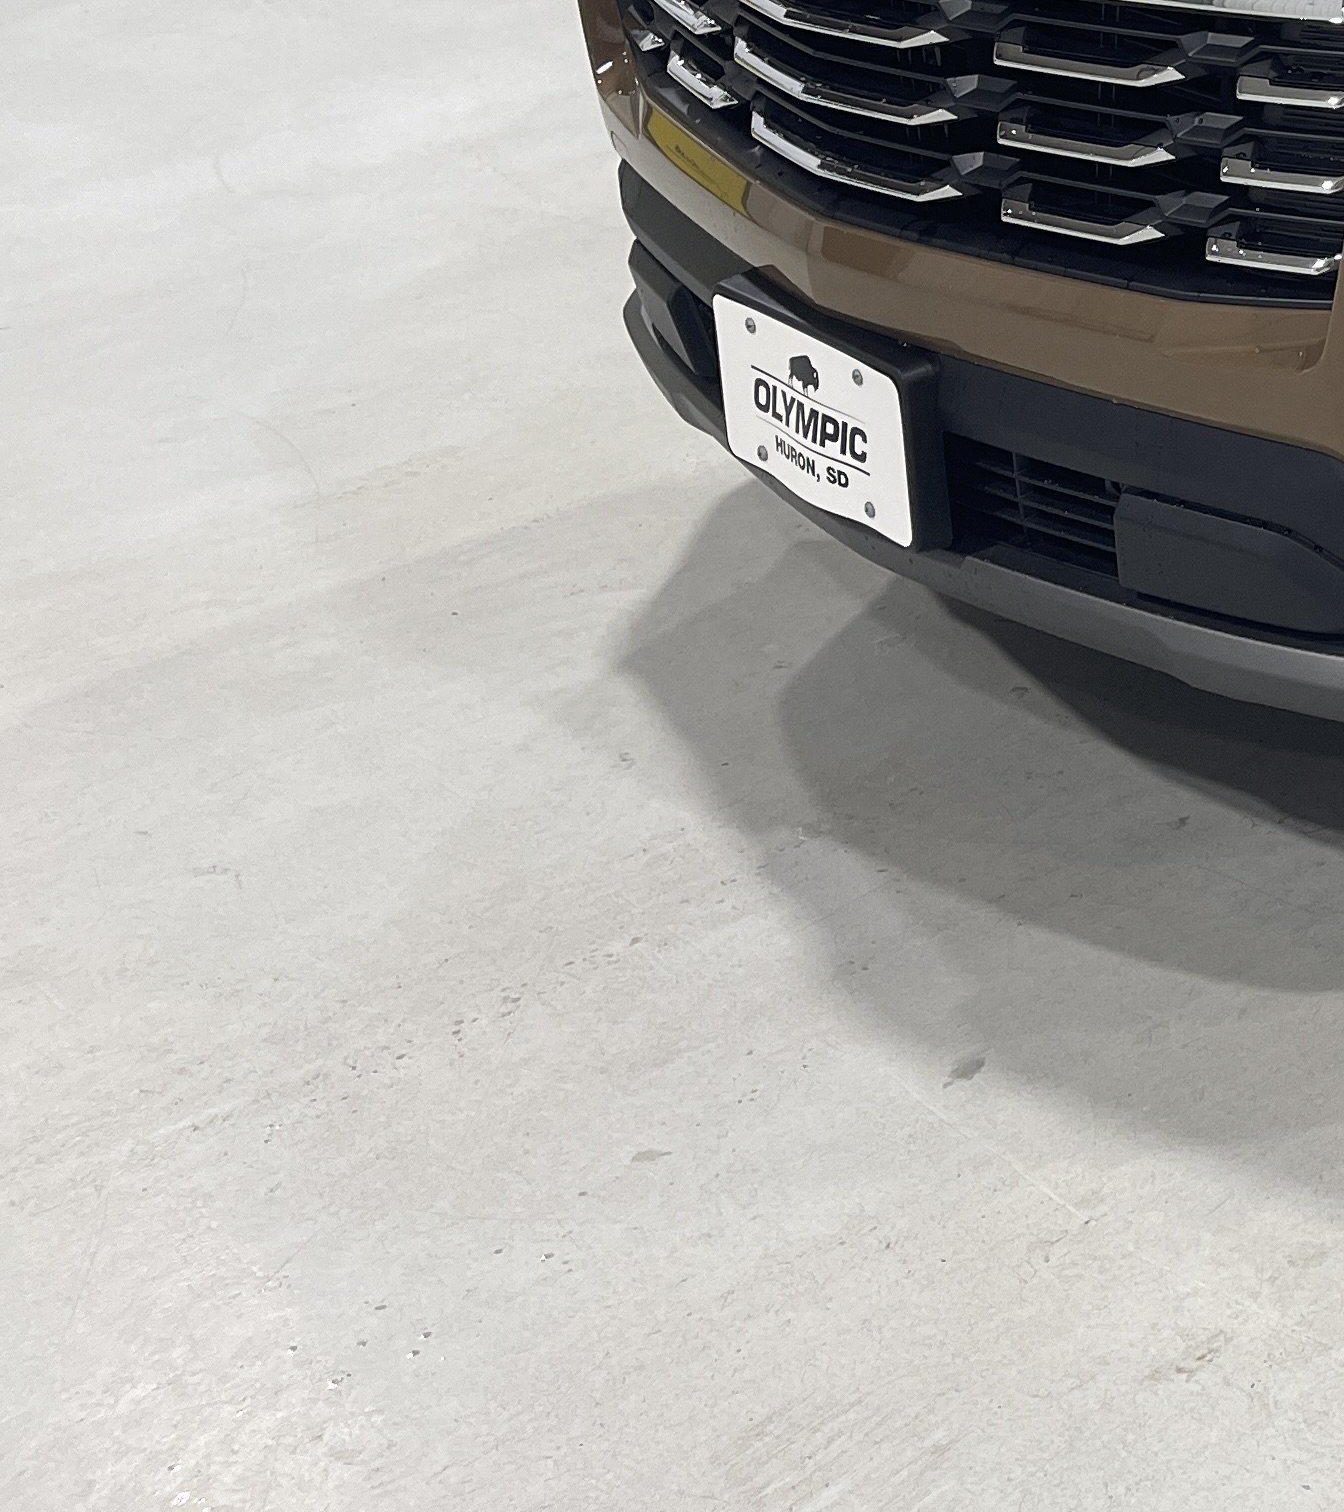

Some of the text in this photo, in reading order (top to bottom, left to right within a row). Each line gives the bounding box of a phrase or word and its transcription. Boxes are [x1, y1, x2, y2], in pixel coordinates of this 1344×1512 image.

[753, 377, 868, 464] OLYMPIC
[775, 434, 849, 489] HURON, SD
